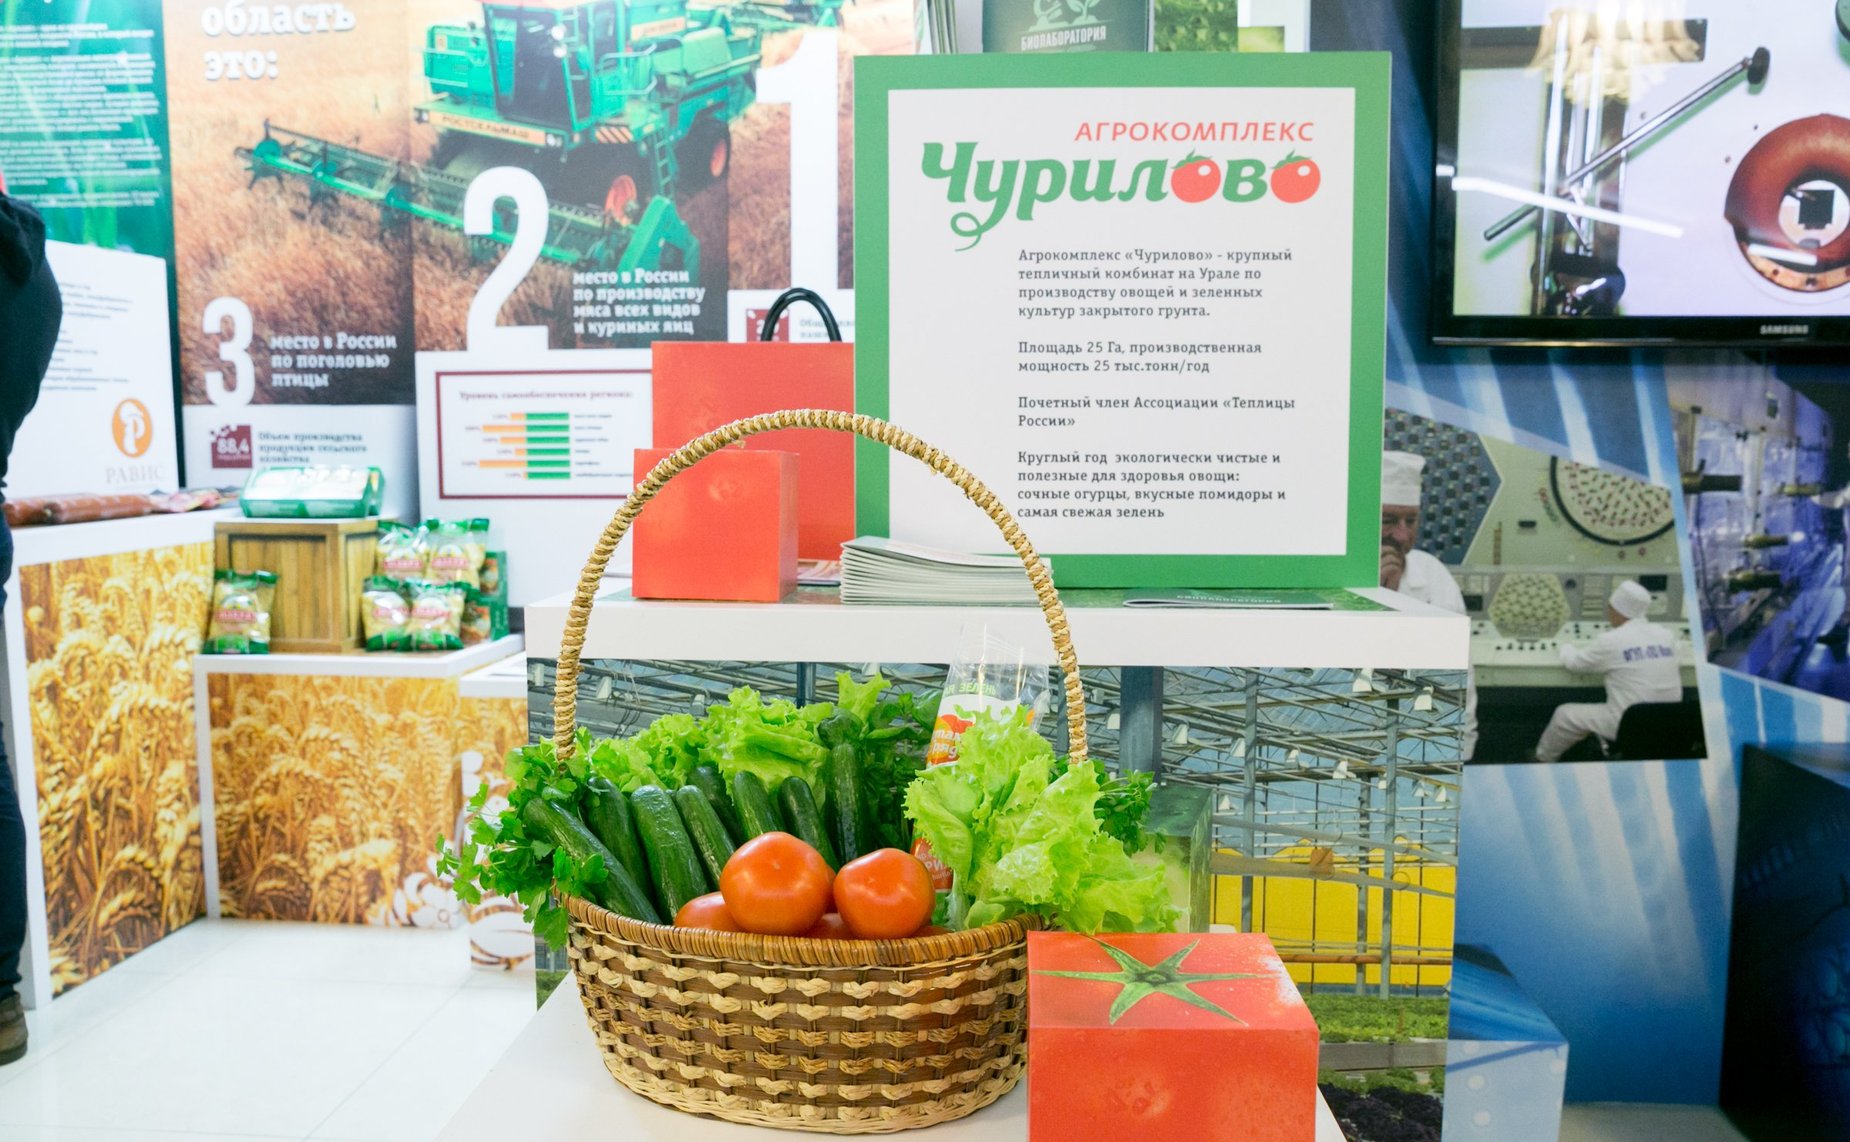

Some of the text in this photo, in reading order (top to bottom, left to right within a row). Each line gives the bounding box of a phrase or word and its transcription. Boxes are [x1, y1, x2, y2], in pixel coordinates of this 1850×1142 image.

[202, 0, 356, 37] область
[1021, 25, 1107, 51] БИОЛАБОРАТОРИЯ
[204, 49, 279, 81] это:
[1074, 121, 1315, 142] АГРОКОМПЛЕКС
[921, 141, 1321, 252] Чурилово
[464, 166, 549, 350] 2
[1018, 249, 1121, 265] Агрокомплекс
[1124, 248, 1213, 264] «Чурилово»
[1226, 247, 1293, 265] крупный
[573, 268, 690, 285] место в России
[1018, 266, 1262, 283] тепличный комбинат на Урале по
[573, 286, 706, 305] по производству
[1018, 285, 1263, 301] производству овощей и зеленных
[573, 303, 701, 319] мяса всех видов
[1018, 306, 1211, 319] культур закрытого грунта.
[574, 320, 694, 337] и куриных яиц
[1760, 324, 1809, 335] SAMSUNG
[271, 332, 398, 350] место в России
[1018, 341, 1262, 356] Площадь 25 Га, производственная
[203, 296, 256, 405] 3
[271, 353, 391, 370] по поголовью
[1018, 359, 1210, 374] мощность 25 тыс.тонн/год
[271, 373, 330, 389] птицы
[1018, 396, 1296, 411] Почетный член Ассоциации «Теплицы
[1018, 414, 1076, 427] России»
[1018, 450, 1281, 466] Круглый год экологически чистые и
[1017, 471, 1240, 484] полезные для здоровья овощи:
[1017, 490, 1286, 503] сочные огурцы, вкусные помидоры и
[1017, 508, 1165, 518] самая свежая зелень
